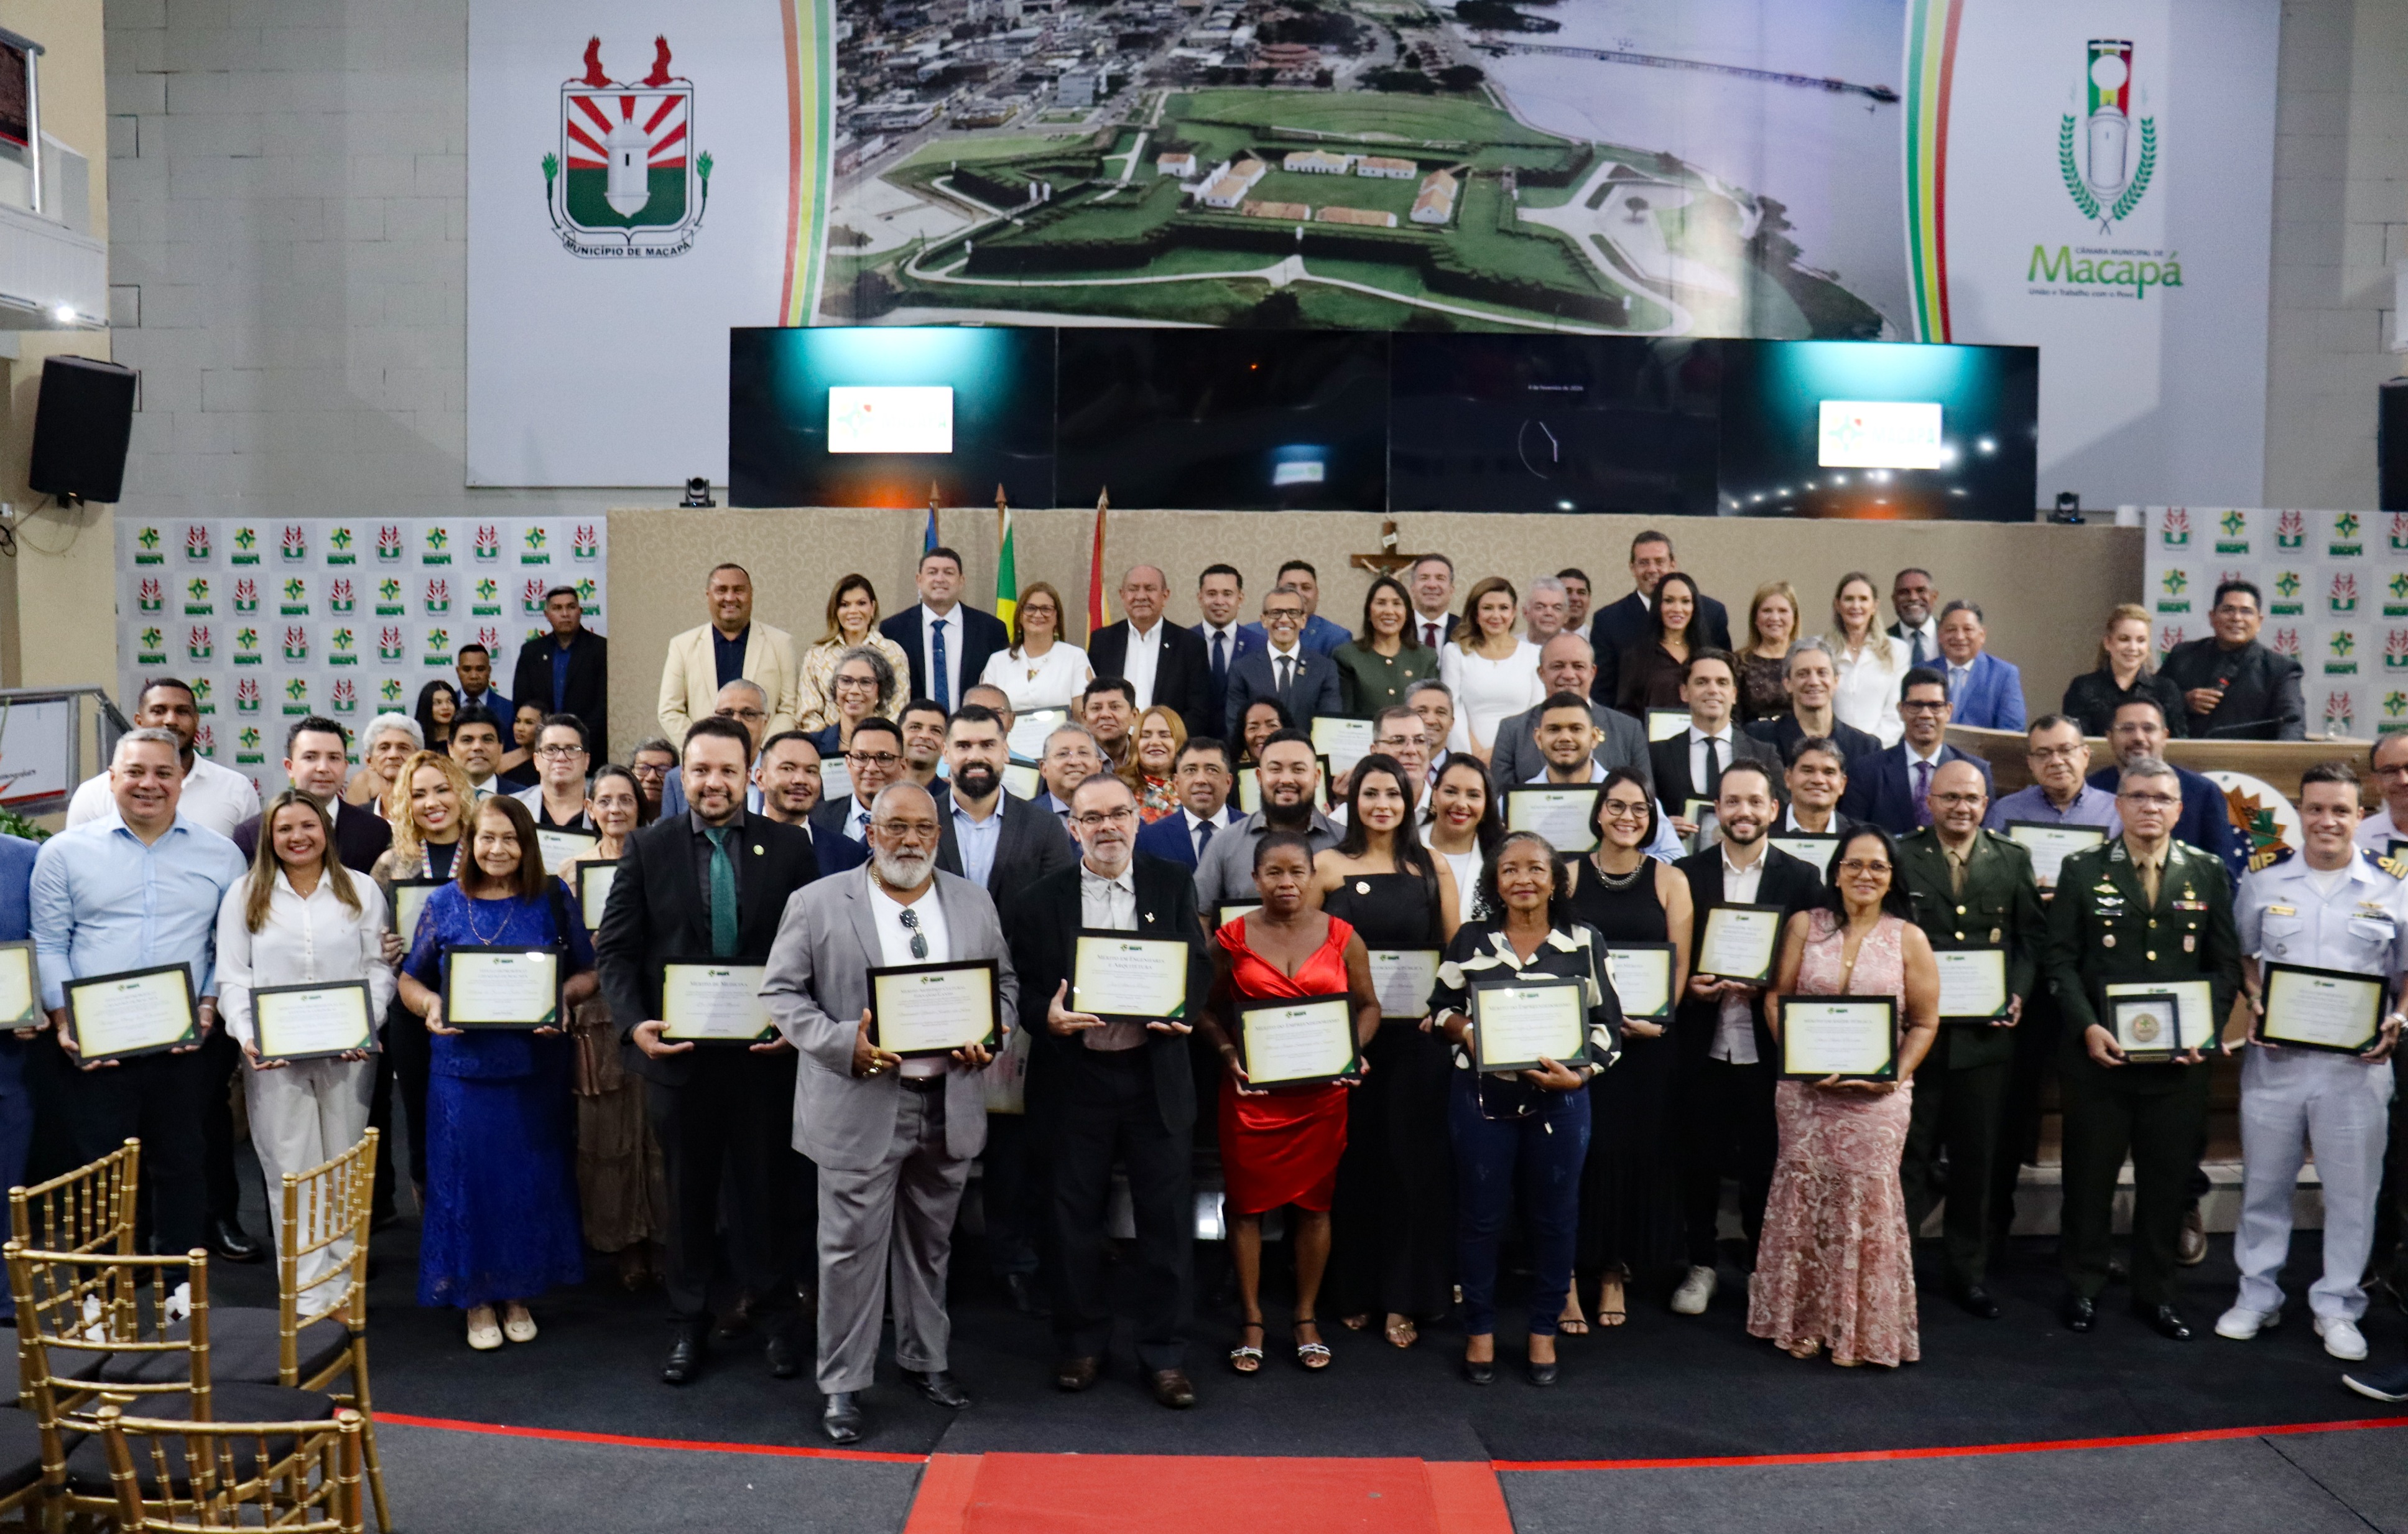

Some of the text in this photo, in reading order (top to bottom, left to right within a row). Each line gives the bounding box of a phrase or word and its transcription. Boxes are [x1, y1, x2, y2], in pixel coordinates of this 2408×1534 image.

[564, 239, 623, 256] MUNICÍPIO
[627, 248, 641, 256] DE
[2027, 244, 2183, 300] Macapá
